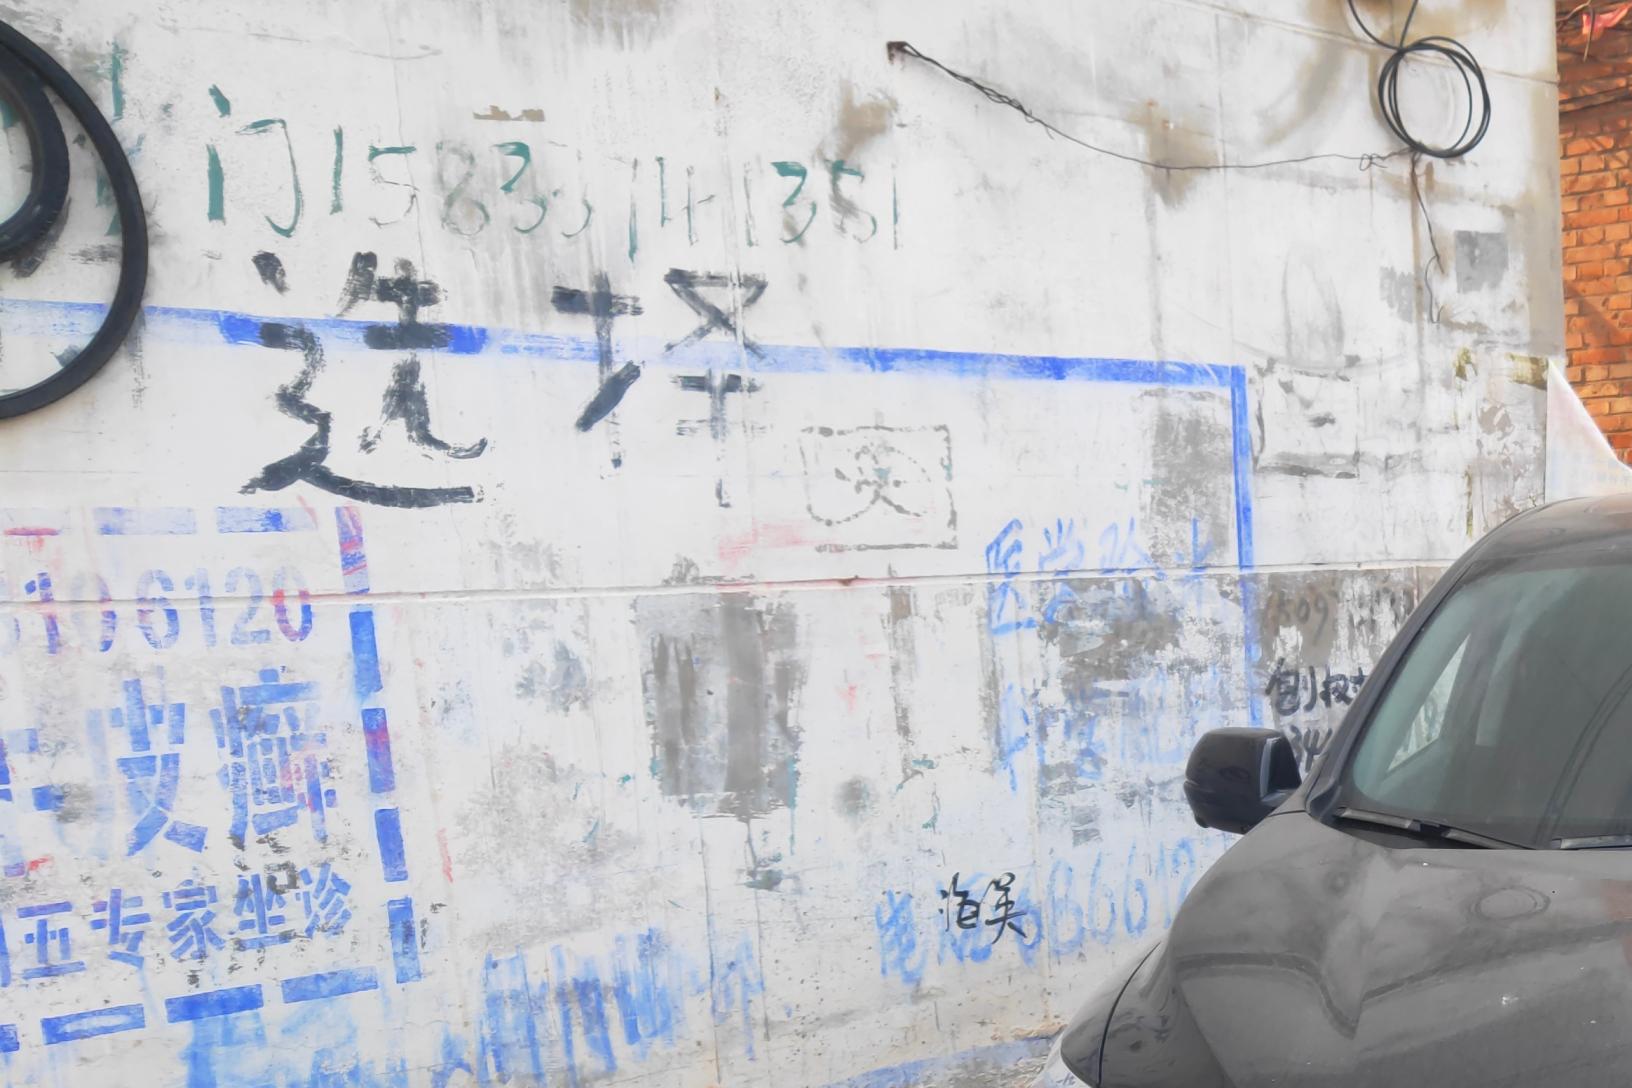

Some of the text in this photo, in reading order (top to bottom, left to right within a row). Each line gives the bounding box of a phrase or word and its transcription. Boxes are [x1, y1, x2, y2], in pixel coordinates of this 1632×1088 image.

[0, 863, 353, 986] 五专家坐诊
